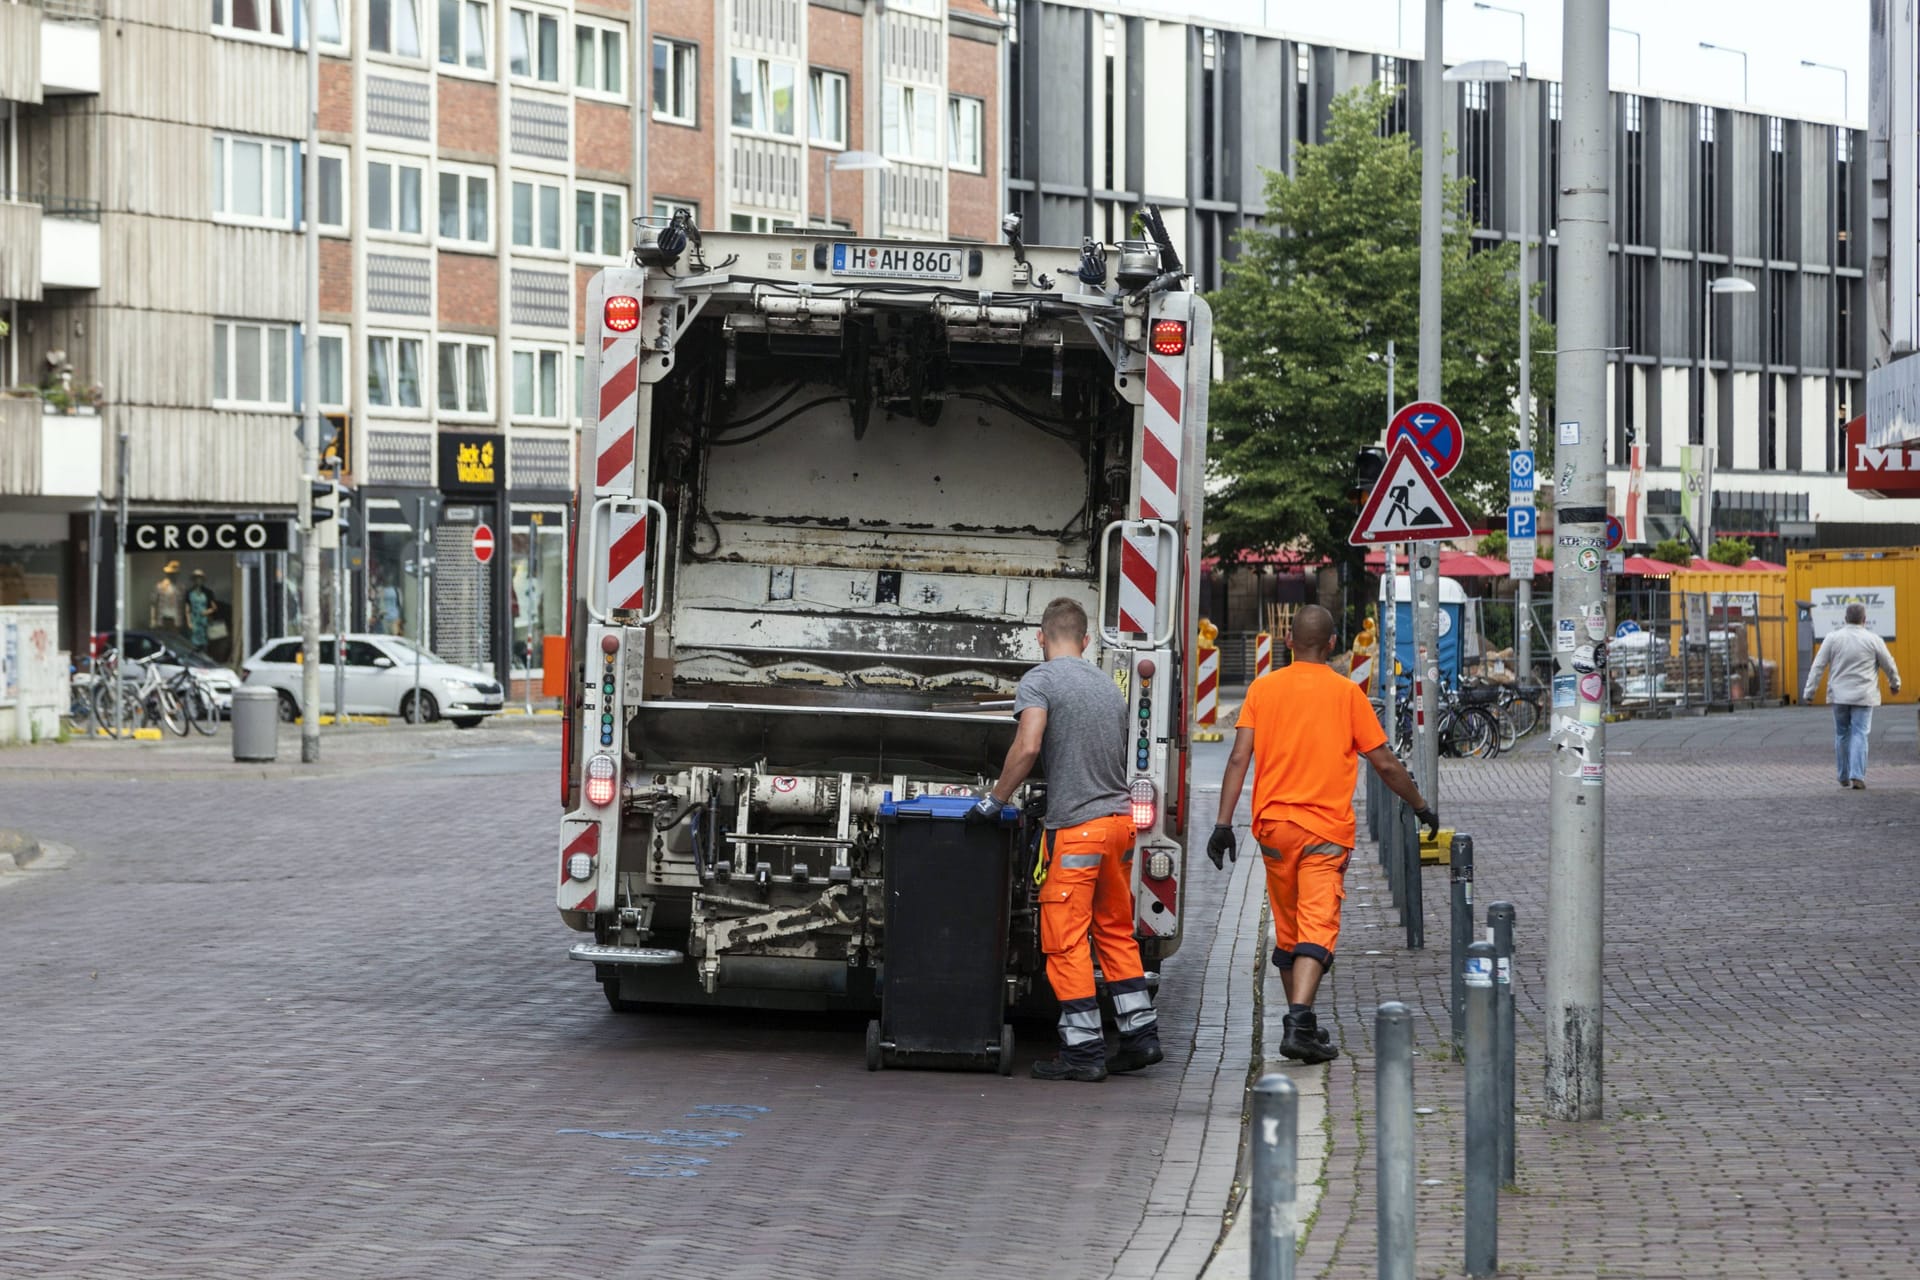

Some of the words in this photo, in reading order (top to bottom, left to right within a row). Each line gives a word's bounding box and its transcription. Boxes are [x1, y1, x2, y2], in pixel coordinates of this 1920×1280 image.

[852, 248, 866, 269] H
[880, 250, 908, 271] AH
[912, 251, 952, 273] 860
[1513, 480, 1532, 488] TAXI
[1514, 510, 1530, 536] P
[136, 524, 267, 549] CROCO
[1800, 610, 1808, 620] P
